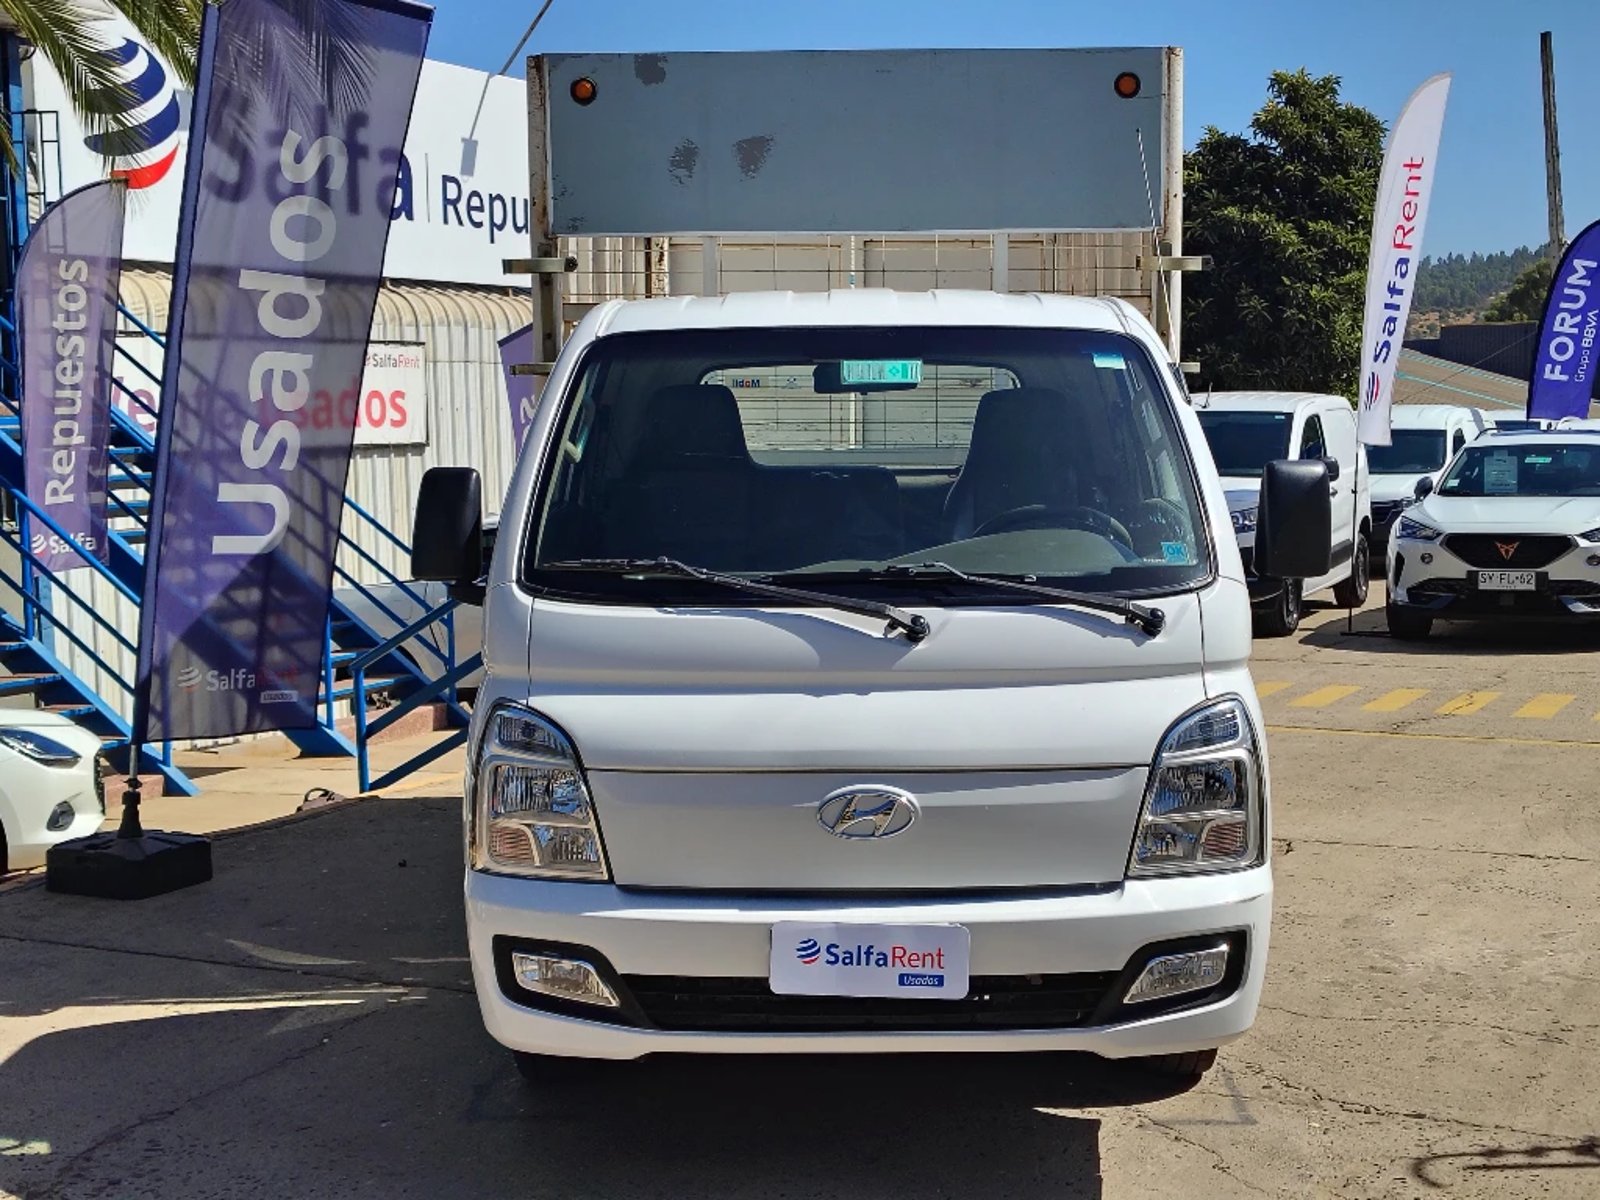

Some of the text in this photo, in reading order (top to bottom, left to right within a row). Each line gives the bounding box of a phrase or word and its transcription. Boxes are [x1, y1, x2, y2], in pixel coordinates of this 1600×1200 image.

[1373, 156, 1425, 364] SalfaRent
[212, 128, 349, 555] Usados
[1543, 258, 1599, 382] FORUM
[1581, 309, 1600, 348] BBVA
[44, 258, 89, 506] Repuestos
[372, 353, 420, 369] SalfaRent
[825, 943, 945, 969] SalfaRent
[903, 974, 939, 986] Usados
